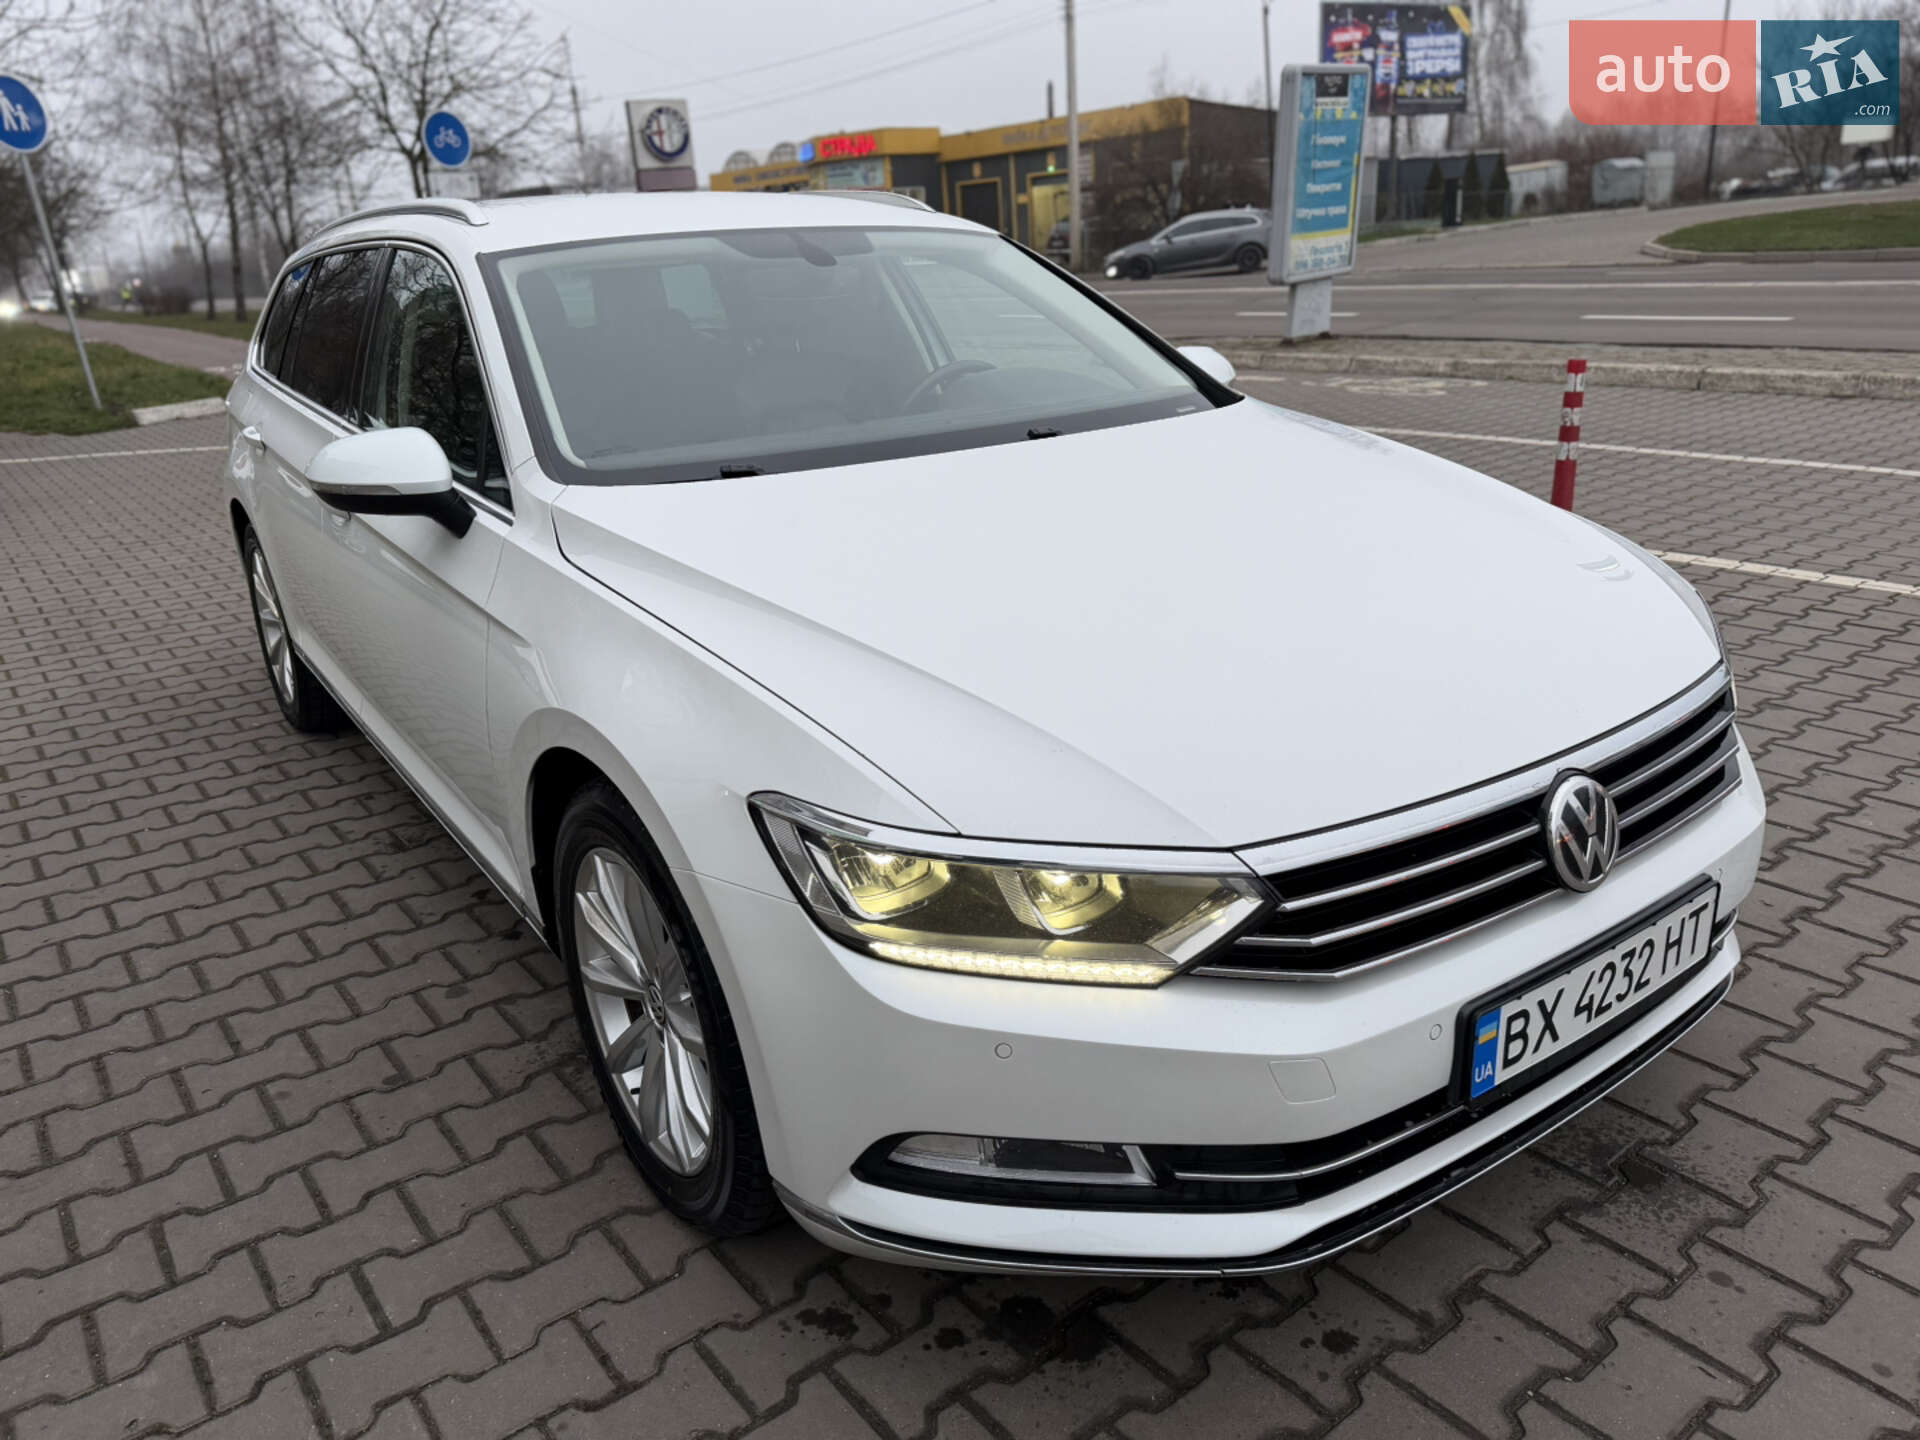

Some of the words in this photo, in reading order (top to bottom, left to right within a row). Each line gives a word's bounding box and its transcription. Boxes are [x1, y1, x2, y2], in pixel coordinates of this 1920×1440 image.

[1502, 988, 1565, 1071] BX
[1574, 938, 1655, 1024] 4232
[1662, 902, 1710, 976] HT
[1475, 1062, 1493, 1083] UA
